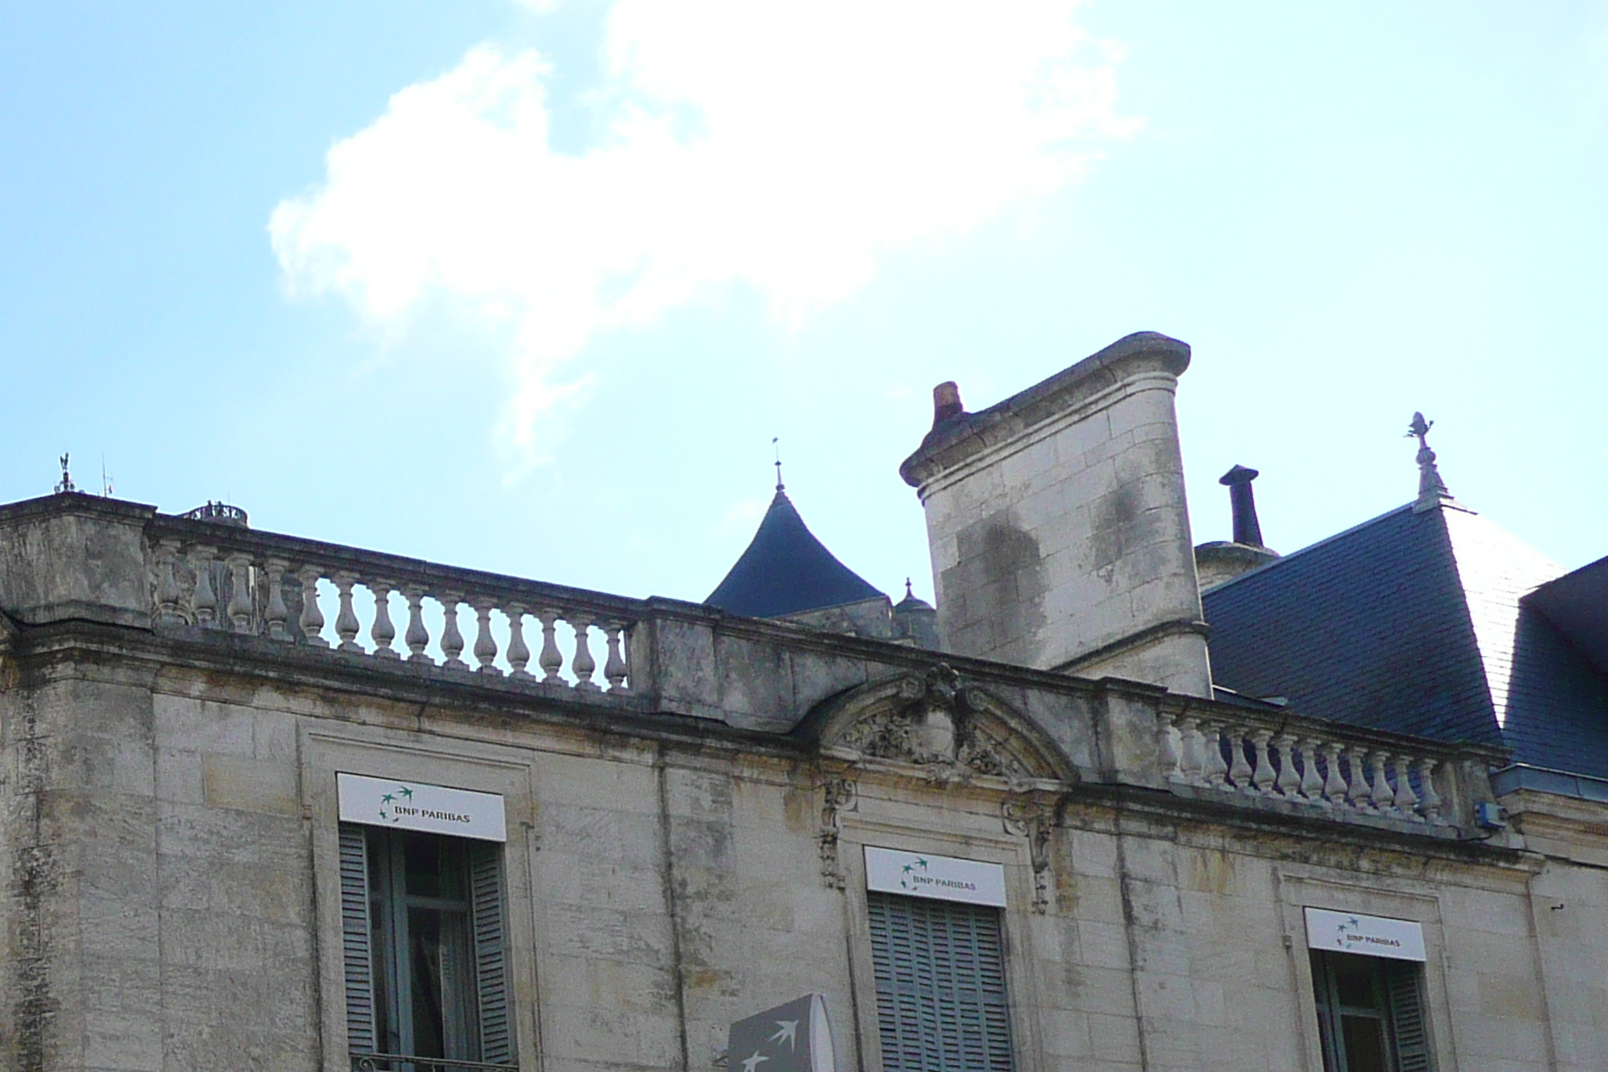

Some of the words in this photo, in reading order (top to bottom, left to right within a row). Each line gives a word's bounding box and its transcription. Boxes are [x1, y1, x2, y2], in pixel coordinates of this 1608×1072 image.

[394, 805, 419, 816] BNP
[421, 809, 471, 823] PARIBAS
[912, 875, 933, 885] BNP
[935, 878, 976, 891] PARIBAS
[1346, 934, 1364, 942] BNP
[1365, 936, 1400, 947] PARIBAS
